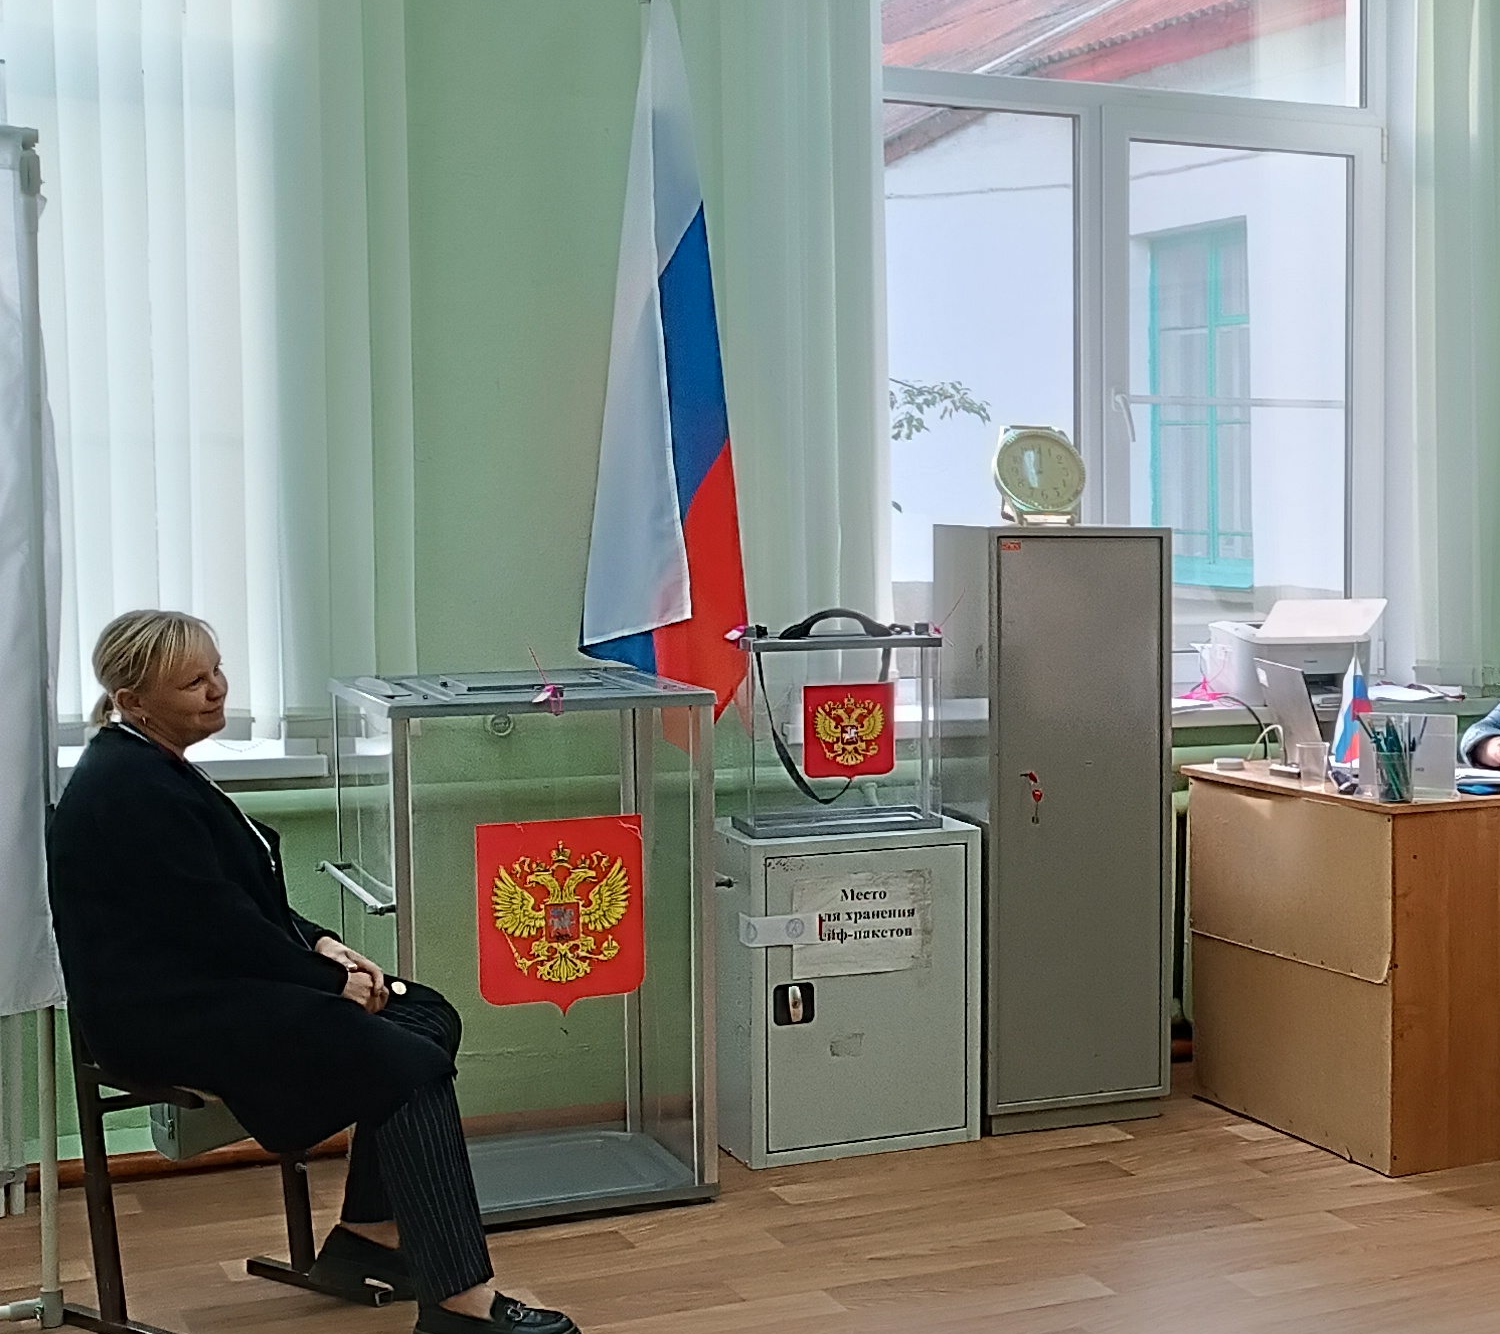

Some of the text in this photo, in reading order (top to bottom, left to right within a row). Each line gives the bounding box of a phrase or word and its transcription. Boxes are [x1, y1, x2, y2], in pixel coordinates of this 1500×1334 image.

[840, 888, 887, 902] Место
[819, 908, 915, 924] ля хранения
